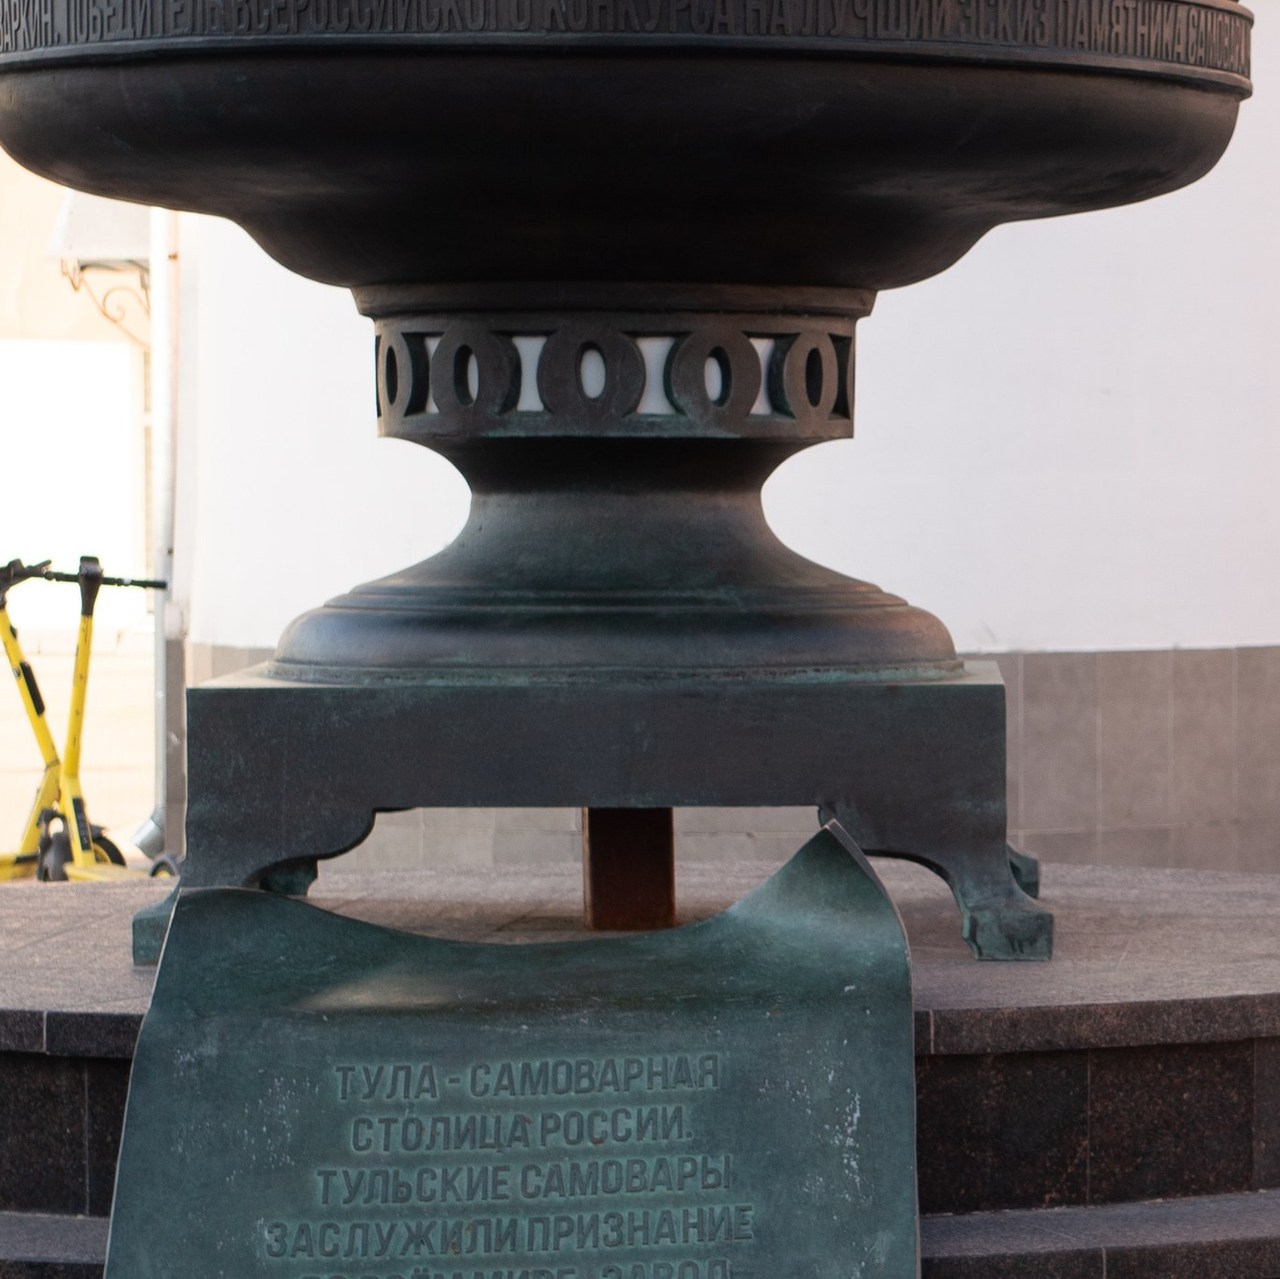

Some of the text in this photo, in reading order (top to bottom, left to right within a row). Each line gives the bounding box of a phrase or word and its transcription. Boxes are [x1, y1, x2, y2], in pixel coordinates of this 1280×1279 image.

[335, 1064, 438, 1100] ТУЛА
[470, 1054, 719, 1097] САМОВАРНАЯ
[351, 1106, 693, 1152] СТОЛИЦА РОССИИ.
[317, 1156, 731, 1205] ТУЛЬСКИЕ САМОВАРЫ
[266, 1205, 753, 1258] ЗАСЛУЖИЛИ ПРИЗНАНИЕ
